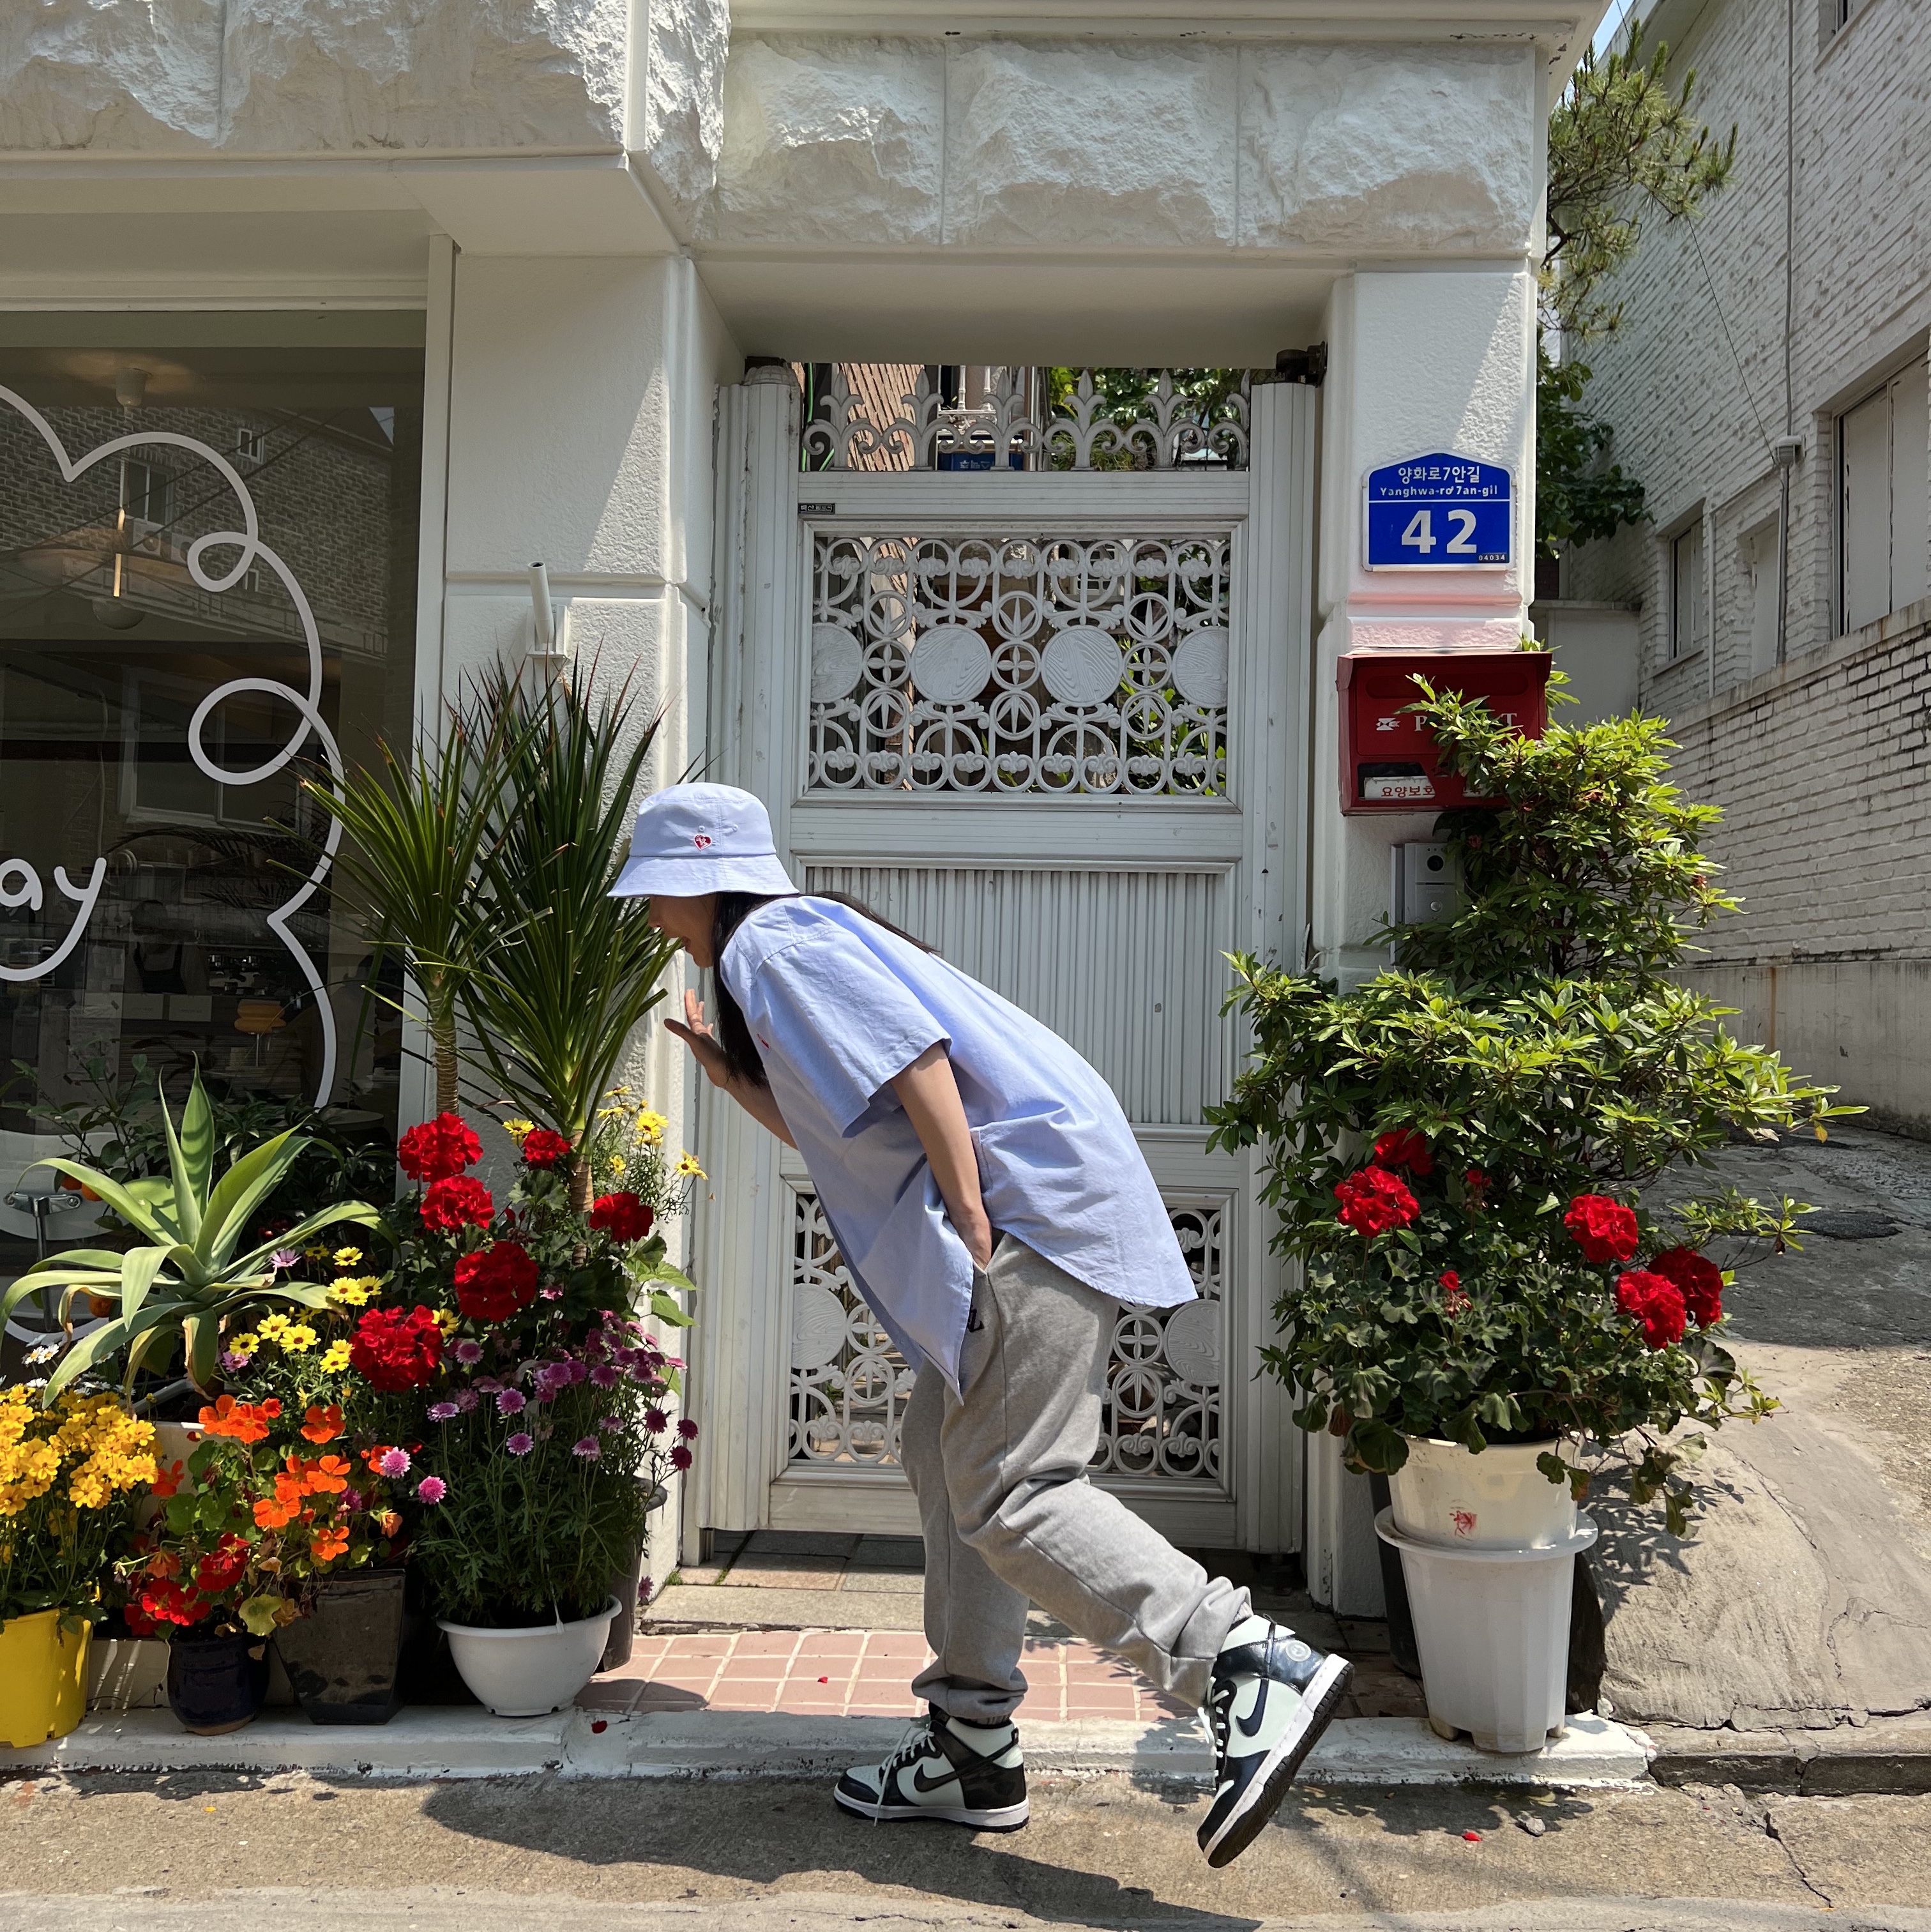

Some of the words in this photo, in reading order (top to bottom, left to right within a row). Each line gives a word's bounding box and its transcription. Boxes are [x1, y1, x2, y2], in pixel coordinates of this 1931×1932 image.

[1398, 466, 1480, 484] 양화로7안길
[1381, 487, 1454, 498] Yanghwa-ro
[1457, 485, 1497, 497] 7an-gil
[1401, 509, 1477, 553] 42
[1414, 713, 1518, 732] PT
